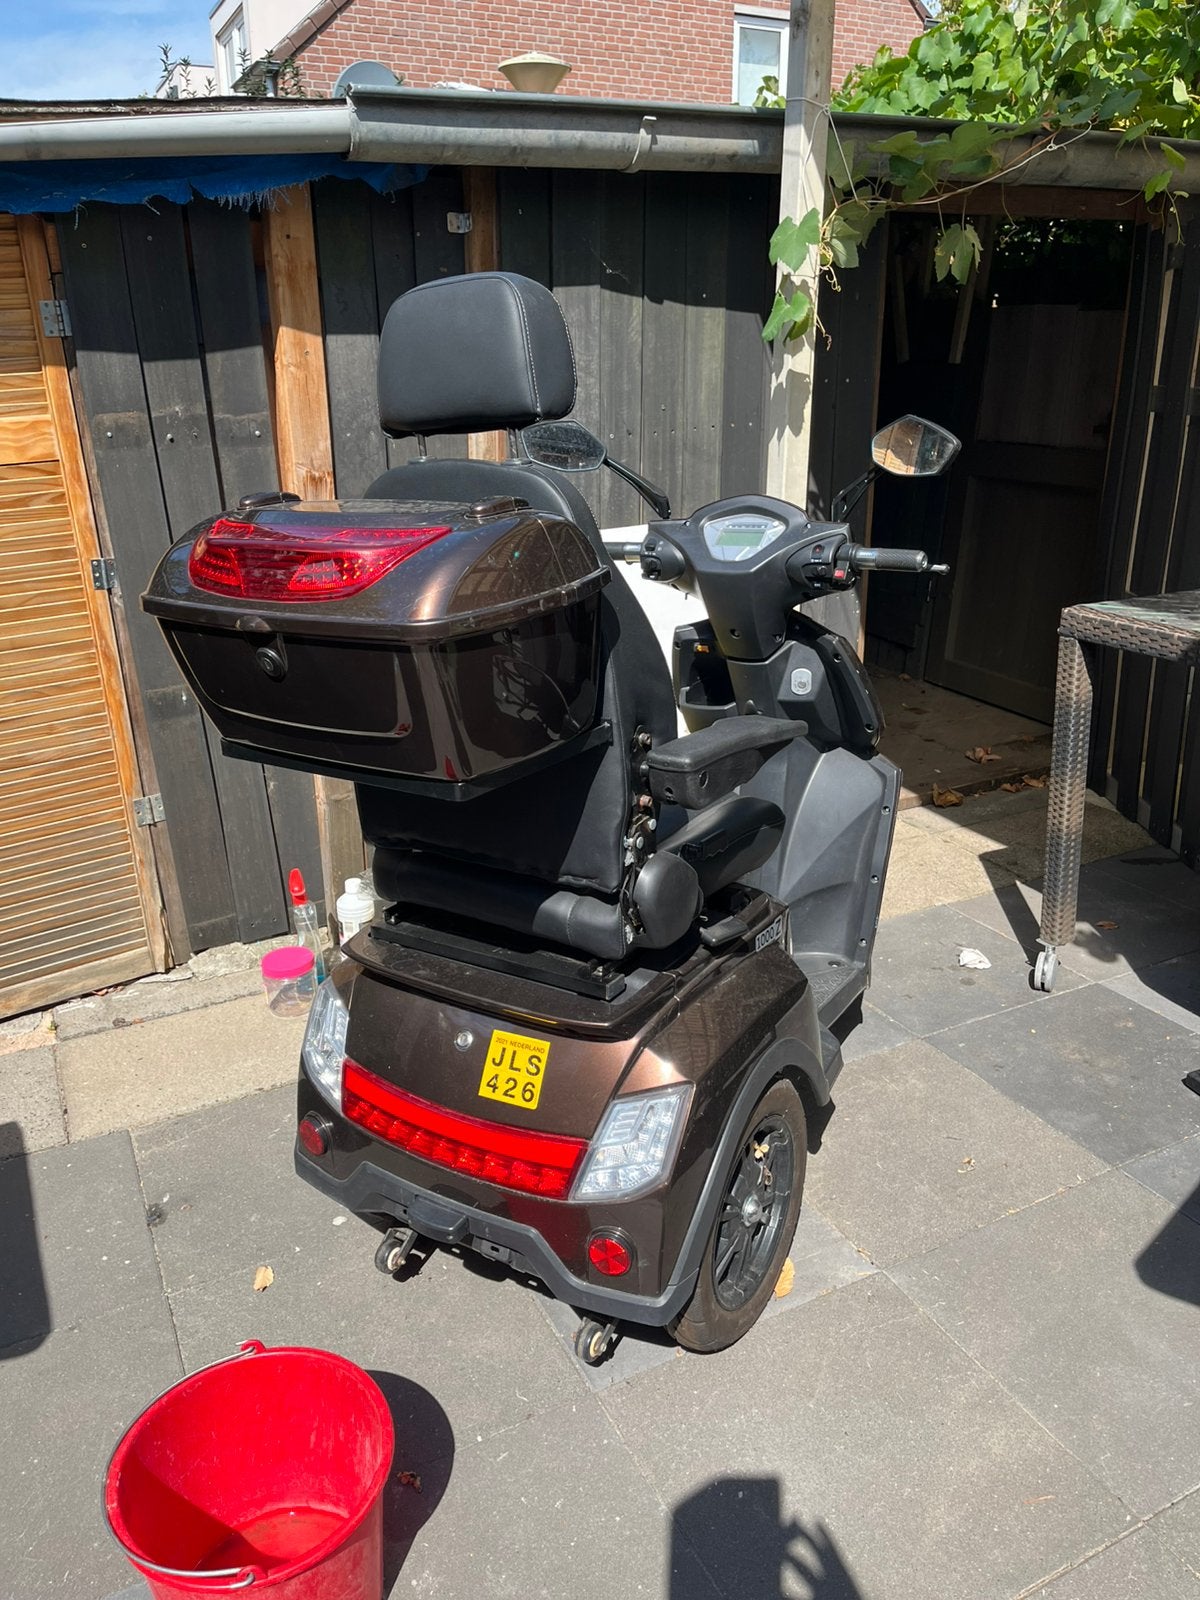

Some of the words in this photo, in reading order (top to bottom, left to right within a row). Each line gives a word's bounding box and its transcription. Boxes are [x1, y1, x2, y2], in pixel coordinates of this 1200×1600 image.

[495, 1036, 508, 1045] 2021
[509, 1040, 546, 1054] NEDERLAND
[491, 1047, 542, 1077] JLS
[486, 1073, 536, 1103] 426
